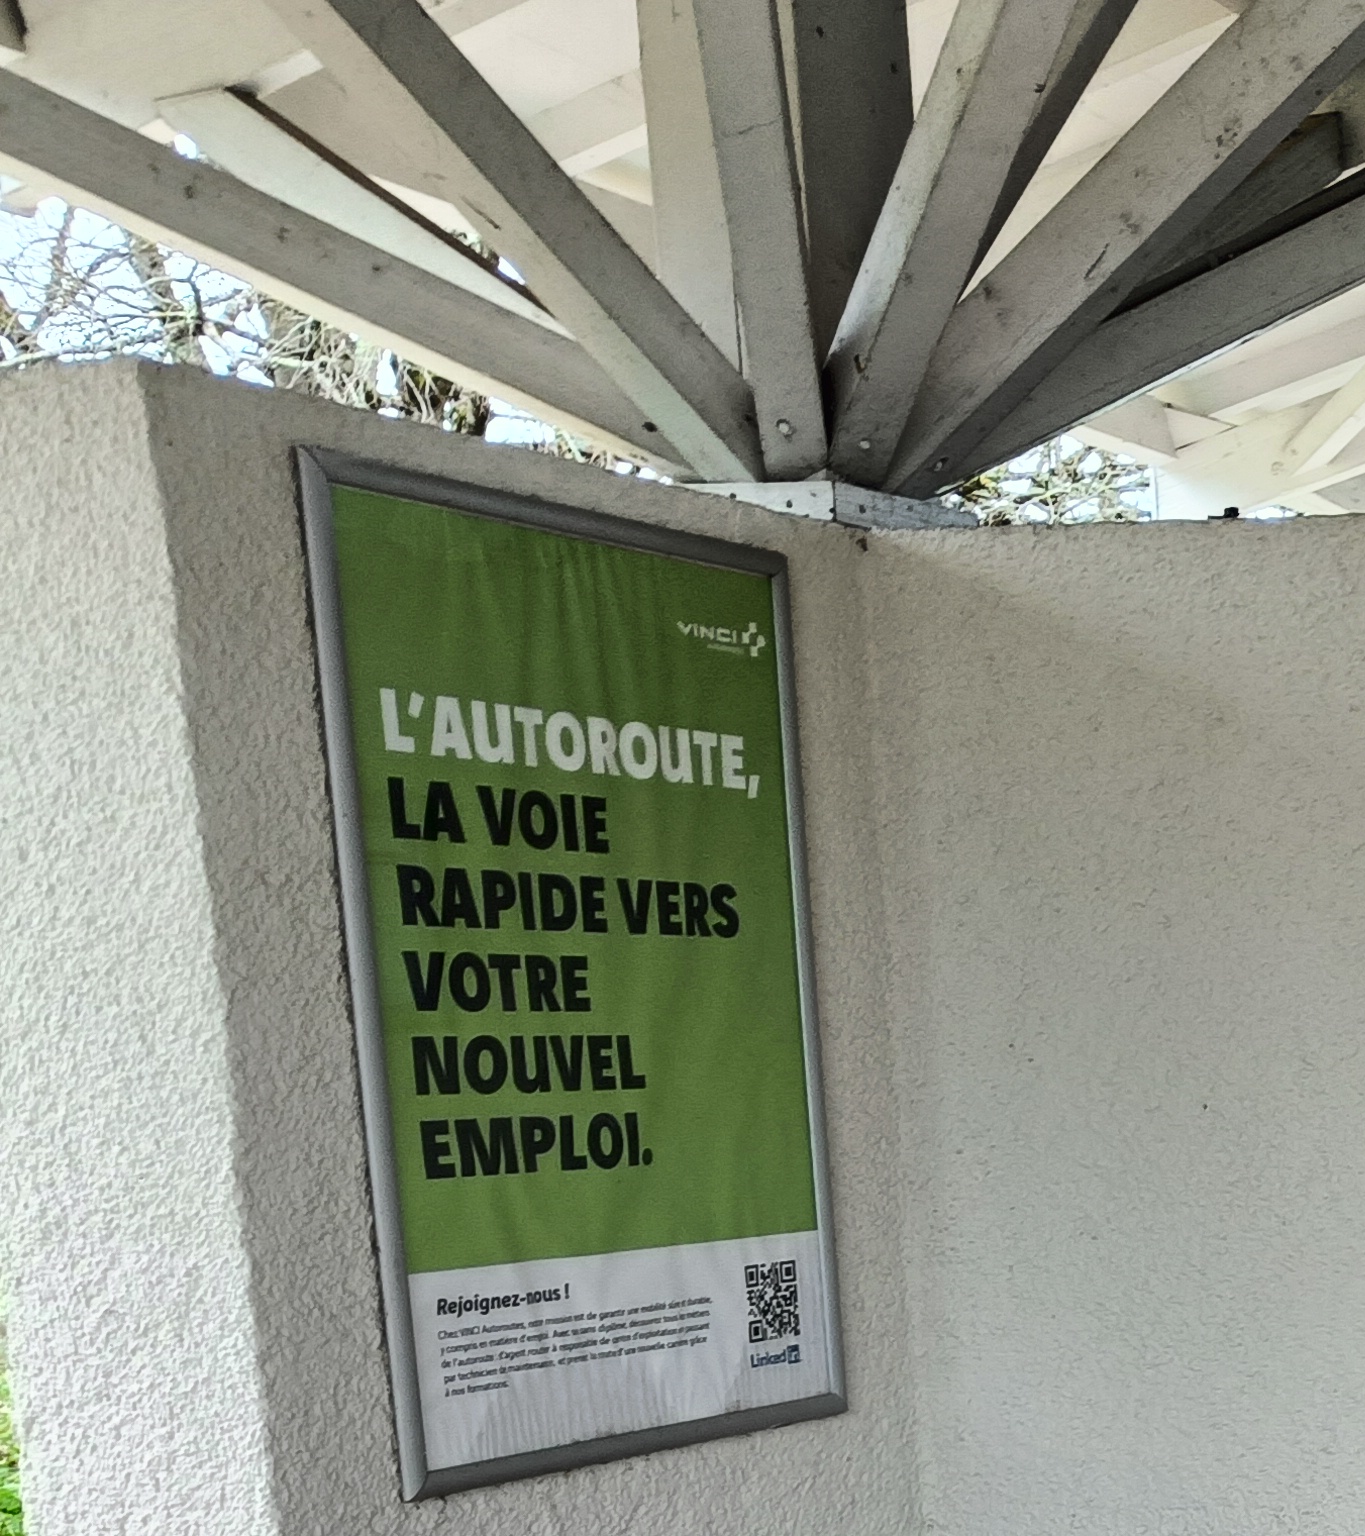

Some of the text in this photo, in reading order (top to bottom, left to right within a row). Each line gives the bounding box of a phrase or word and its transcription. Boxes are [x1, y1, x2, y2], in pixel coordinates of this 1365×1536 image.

[676, 621, 737, 644] VINCI
[387, 776, 610, 854] LA VOIE
[397, 864, 740, 938] RAPIDE VERS
[402, 949, 591, 1014] VOTRE
[410, 1033, 645, 1096] NOUVEL
[419, 1111, 653, 1179] EMPLOI.
[437, 1288, 561, 1318] Rejoignez-nous
